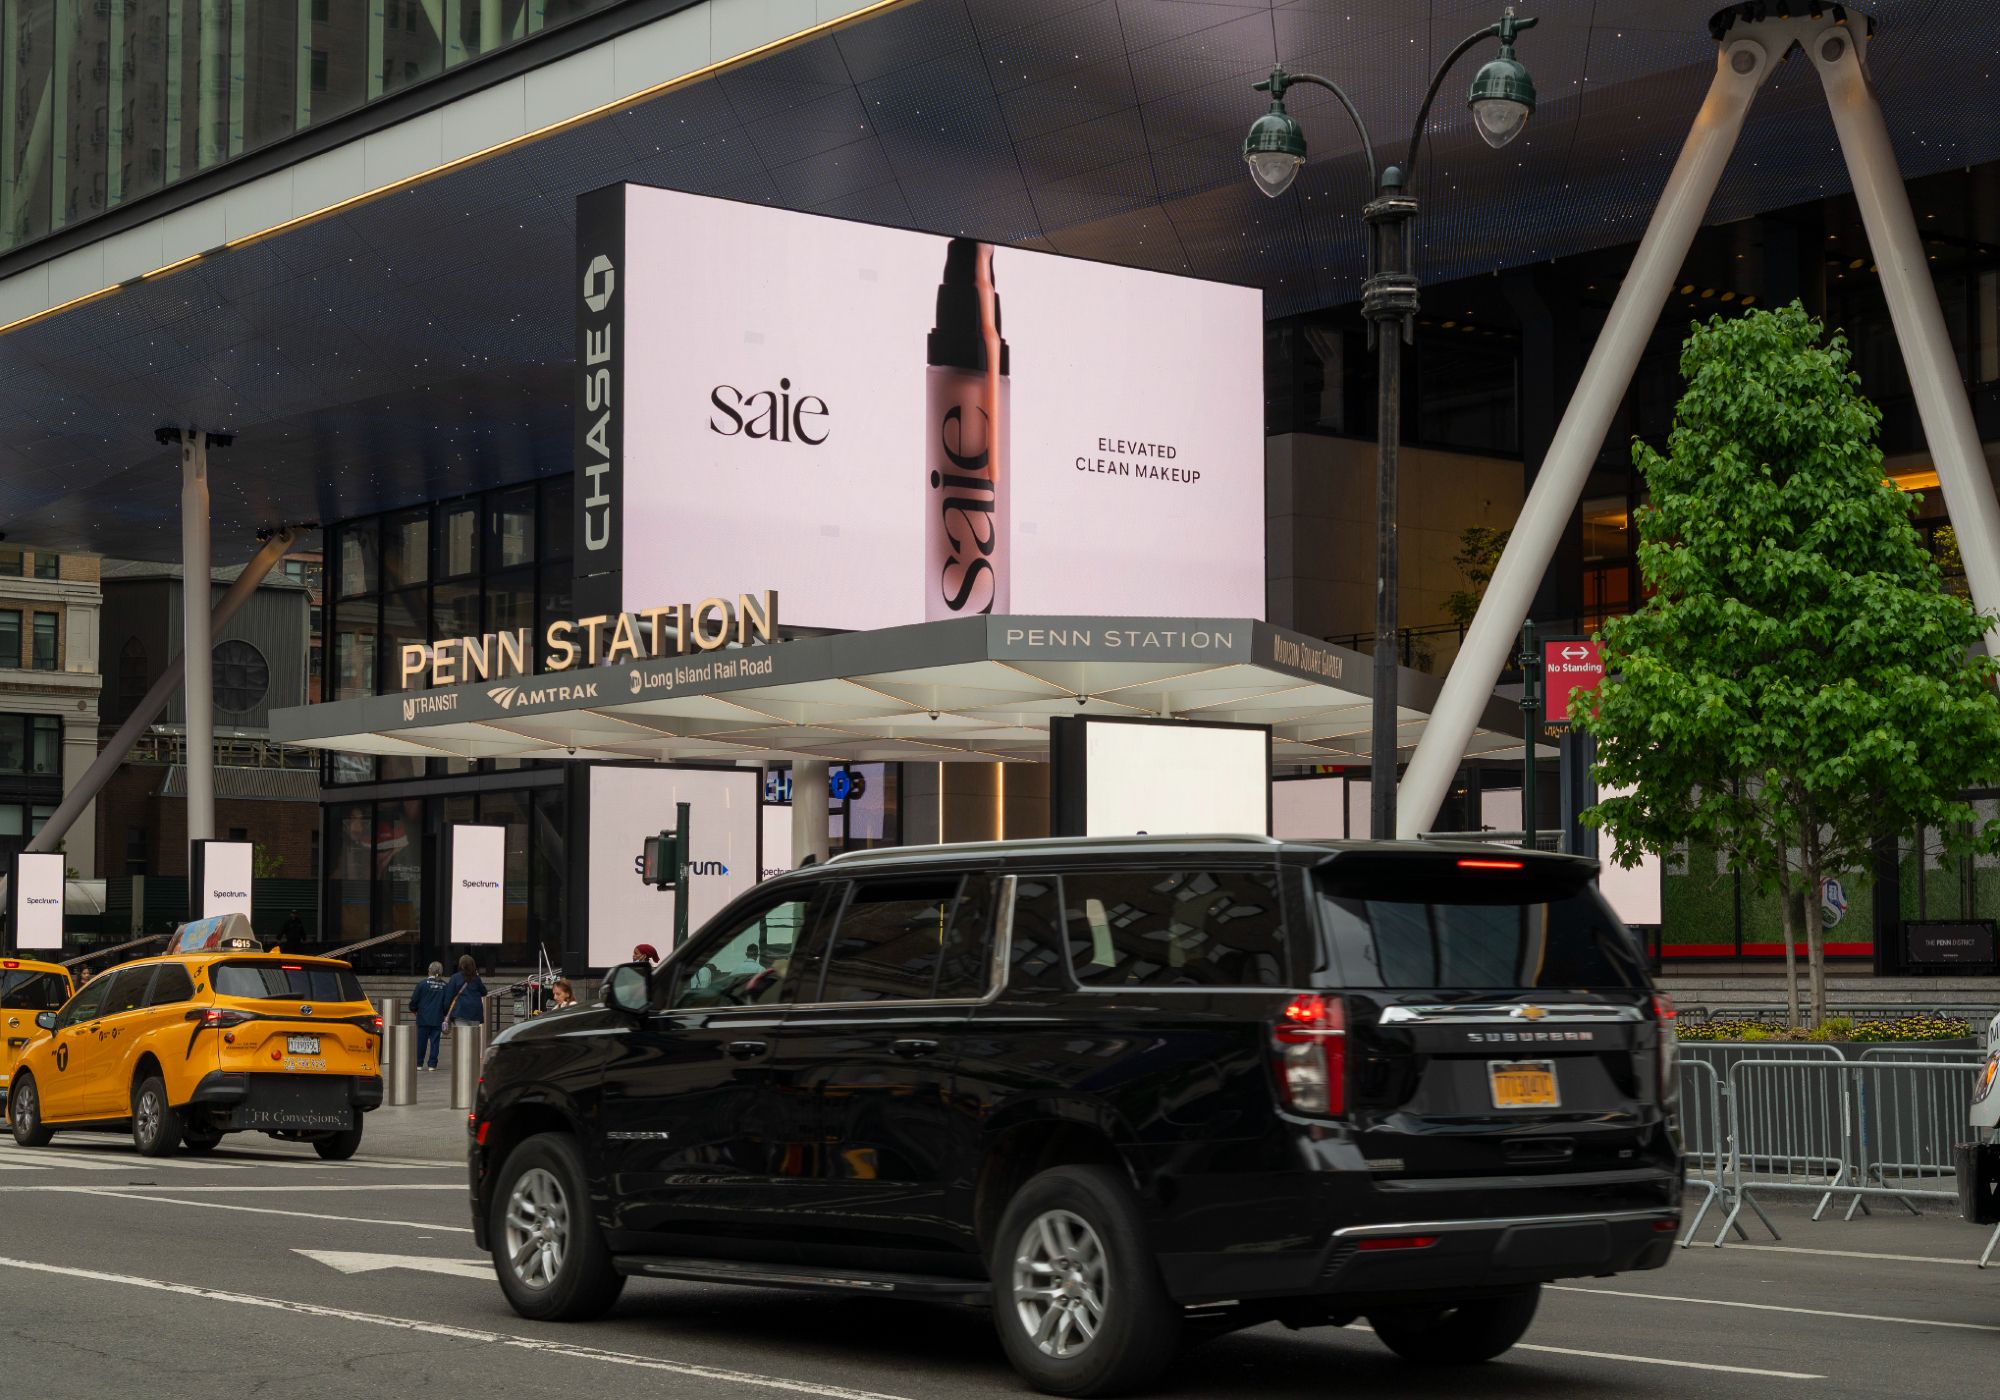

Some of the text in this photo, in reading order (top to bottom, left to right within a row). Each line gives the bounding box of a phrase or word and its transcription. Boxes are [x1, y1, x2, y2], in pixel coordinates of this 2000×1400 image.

[710, 377, 830, 445] saie
[585, 322, 611, 551] CHASE
[1098, 437, 1177, 459] ELEVATED
[1075, 456, 1201, 484] CLEAN MAKEUP
[930, 405, 995, 614] saie
[402, 589, 778, 689] PENN STATION
[1006, 629, 1233, 649] PENN STATION
[1273, 634, 1343, 679] MADISON SQUARE GARDEN
[644, 671, 673, 691] Long
[675, 663, 711, 685] Island
[714, 660, 738, 681] Rail
[740, 656, 773, 678] Road
[1547, 662, 1602, 674] No Standing
[516, 683, 598, 707] AMTRAK
[213, 890, 246, 899] Spectrum
[462, 879, 497, 889] Spectrum
[26, 897, 57, 906] Spectrum
[1936, 938, 1952, 947] PENN
[1467, 1032, 1593, 1042] SUBURBAN
[273, 1110, 340, 1124] Conversions
